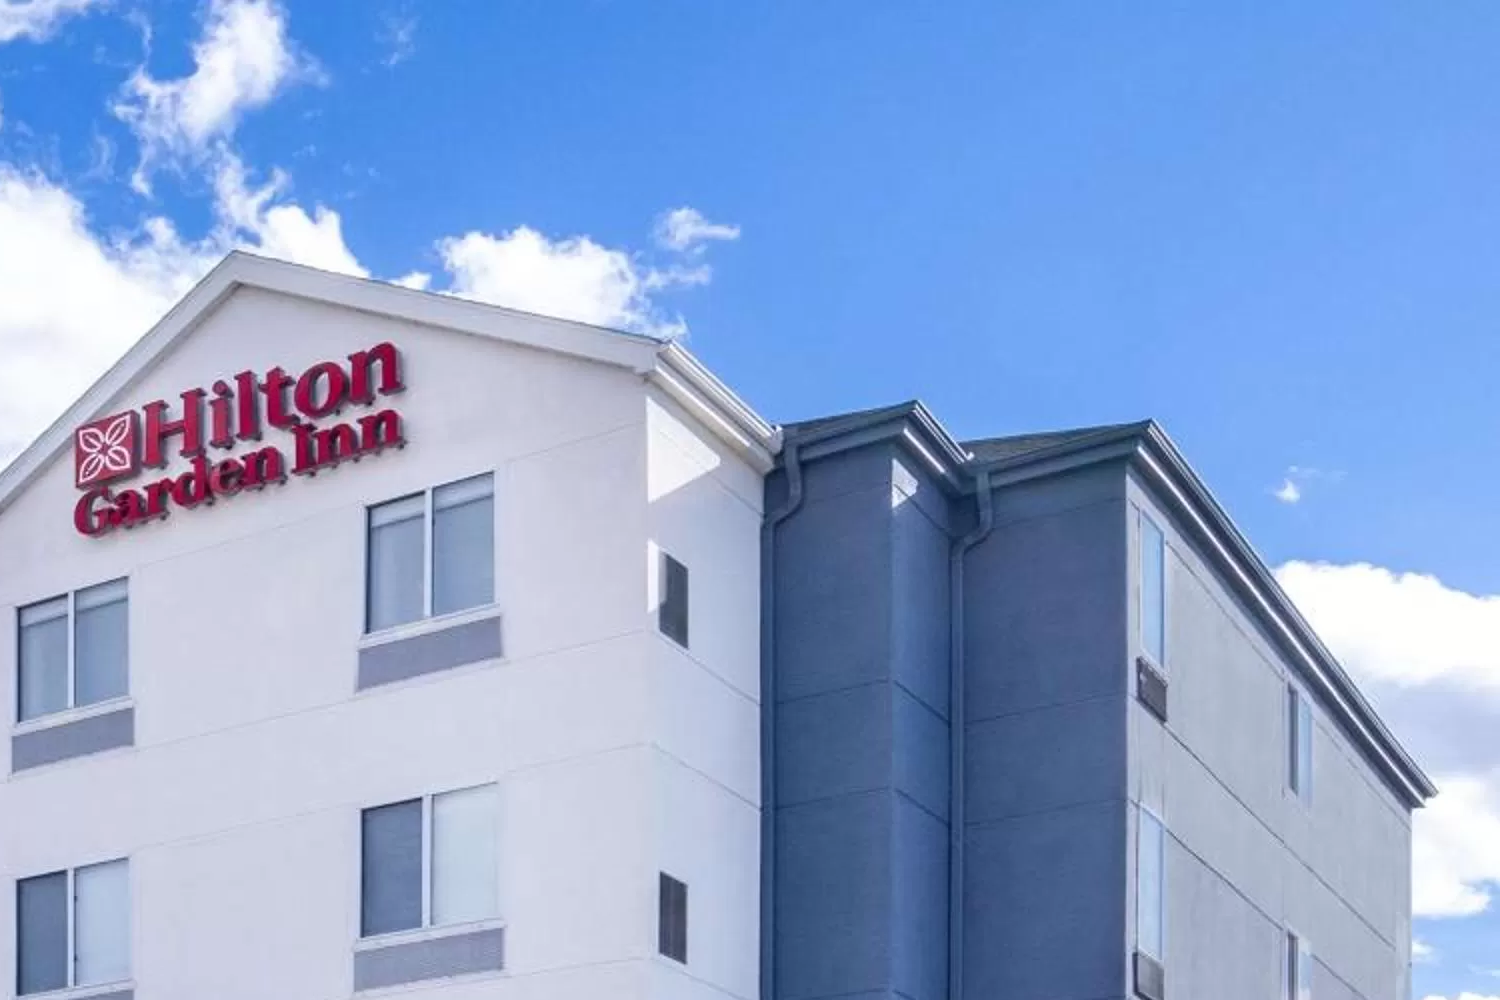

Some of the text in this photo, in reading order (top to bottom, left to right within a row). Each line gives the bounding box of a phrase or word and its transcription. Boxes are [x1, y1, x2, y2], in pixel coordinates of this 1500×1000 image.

[143, 341, 403, 467] Hilton
[74, 409, 403, 536] Garden Inn
